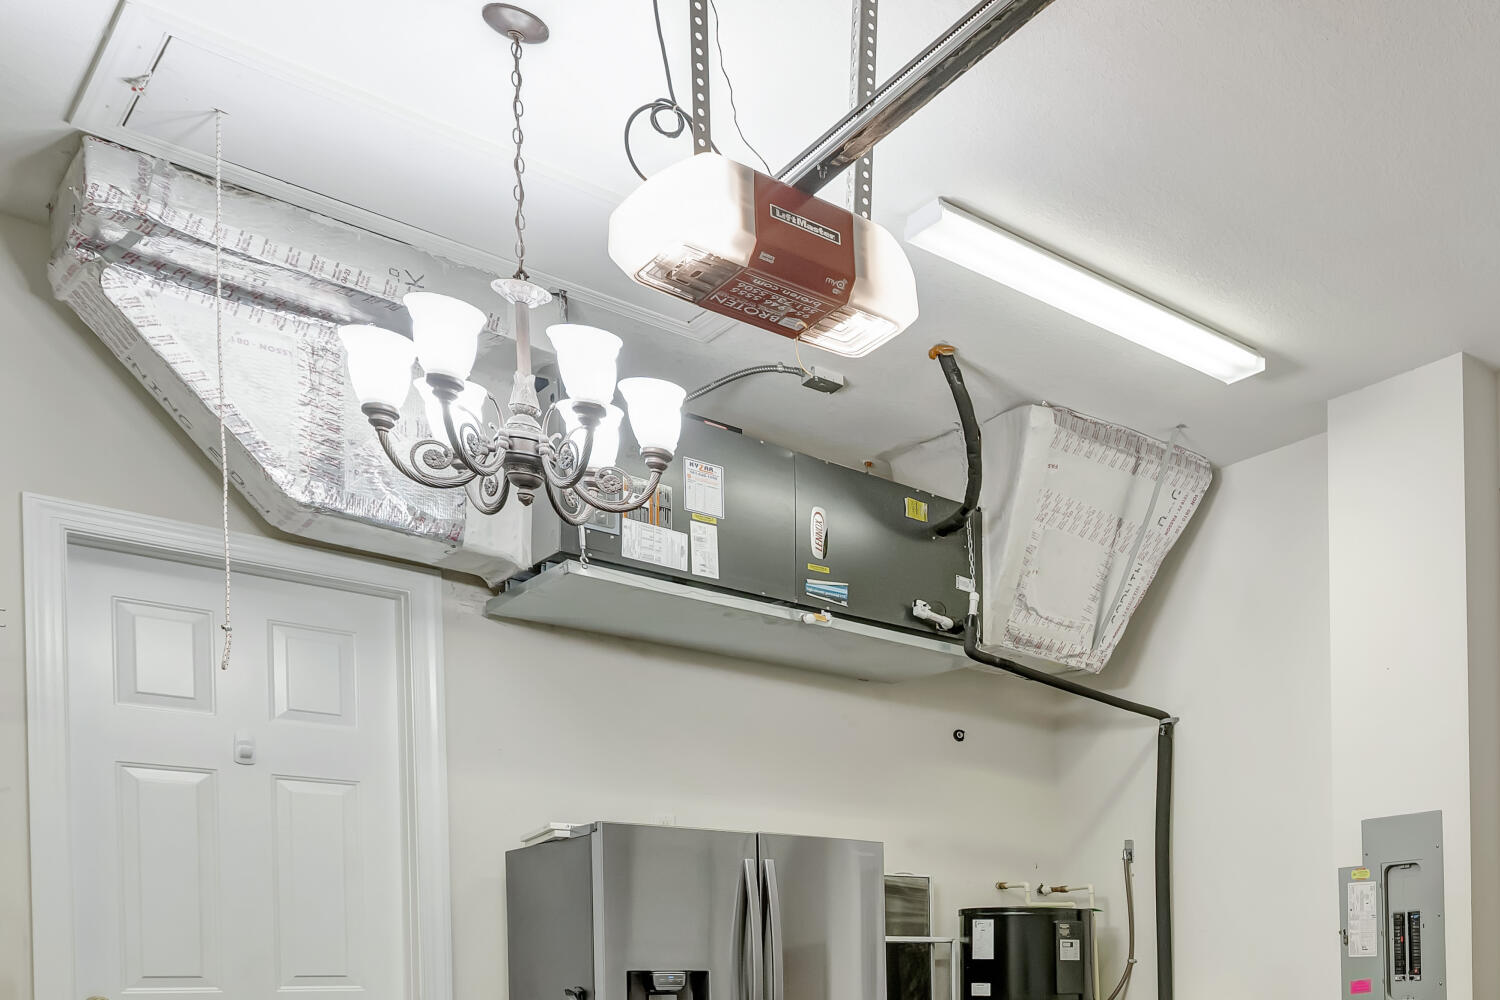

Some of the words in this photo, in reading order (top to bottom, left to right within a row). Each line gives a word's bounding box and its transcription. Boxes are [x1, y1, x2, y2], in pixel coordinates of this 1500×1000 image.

[775, 207, 836, 241] LiftMaster
[710, 294, 780, 322] BROTEN
[730, 287, 810, 319] 954946.5555
[751, 278, 822, 308] broten.com
[815, 519, 823, 553] LENNOX
